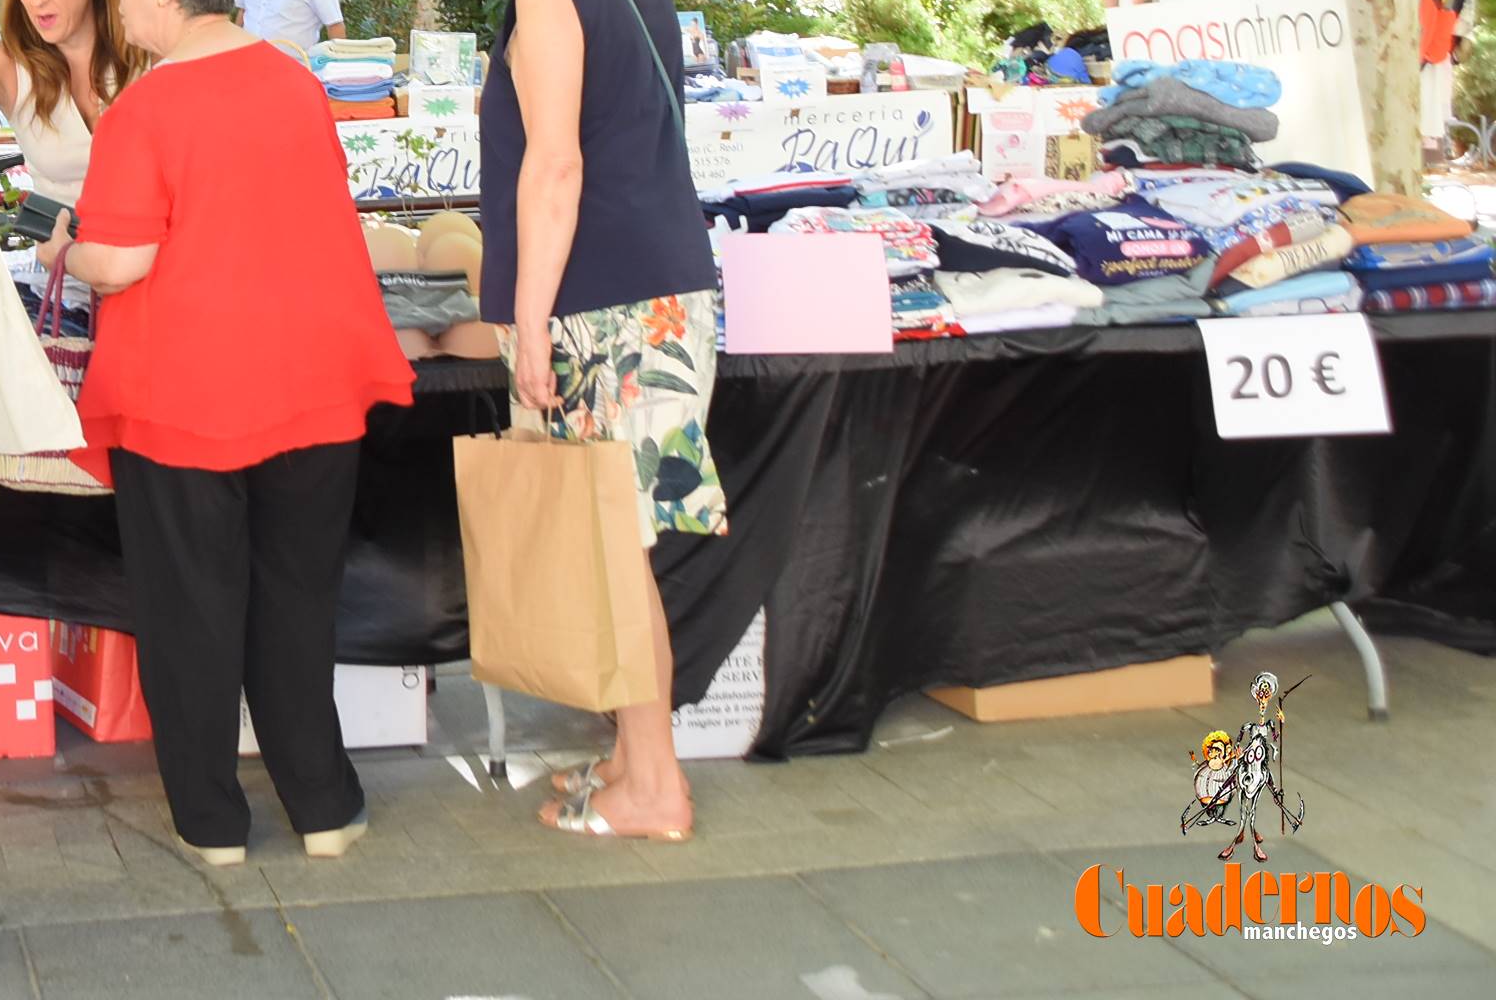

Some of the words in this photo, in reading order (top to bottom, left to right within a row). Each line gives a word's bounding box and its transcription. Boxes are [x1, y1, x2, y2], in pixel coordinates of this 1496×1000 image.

[1105, 229, 1124, 243] MI
[1126, 228, 1165, 241] CAMA
[1226, 353, 1293, 400] 20
[1310, 350, 1346, 396] €
